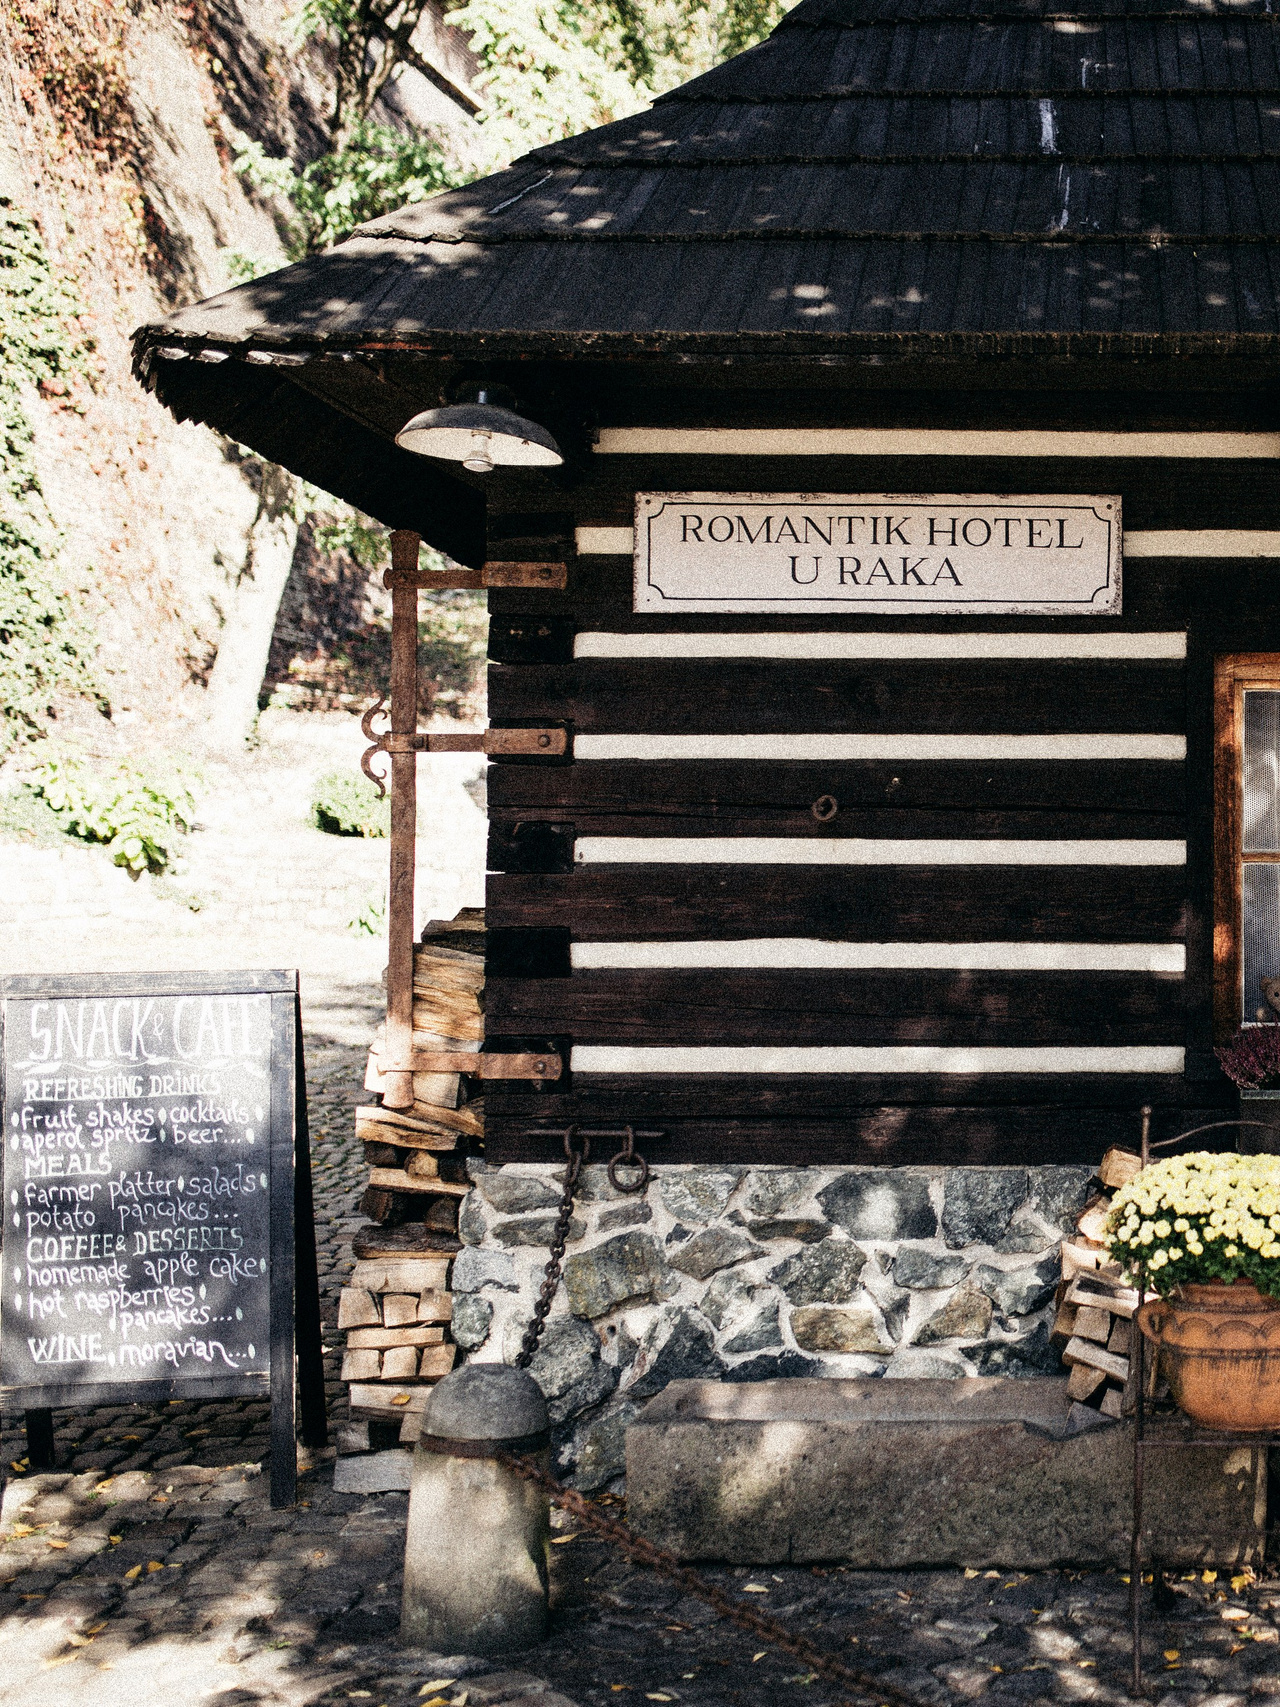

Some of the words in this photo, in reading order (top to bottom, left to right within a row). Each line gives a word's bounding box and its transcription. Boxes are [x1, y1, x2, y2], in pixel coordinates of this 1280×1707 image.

[679, 514, 914, 547] ROMANTIK
[927, 518, 1085, 549] HOTEL
[788, 555, 822, 586] U
[837, 556, 964, 587] RAKA
[28, 1000, 156, 1060] SNACK
[153, 1012, 164, 1037] &
[21, 1105, 78, 1129] fruit
[87, 1101, 155, 1128] shakes
[169, 1099, 250, 1125] cocktails
[22, 1131, 85, 1157] aperol
[91, 1125, 157, 1152] spritz
[25, 1151, 112, 1178] MEALS
[24, 1182, 101, 1207] farmer
[108, 1171, 177, 1209] platter
[186, 1163, 256, 1200] salads
[26, 1202, 95, 1238] potato
[132, 1227, 243, 1257] DESSERTS
[26, 1258, 131, 1287] homemade
[143, 1251, 200, 1285] apple
[209, 1253, 258, 1285] cake
[28, 1288, 68, 1320] hot
[74, 1283, 195, 1320] raspberries
[27, 1332, 106, 1364] WINE
